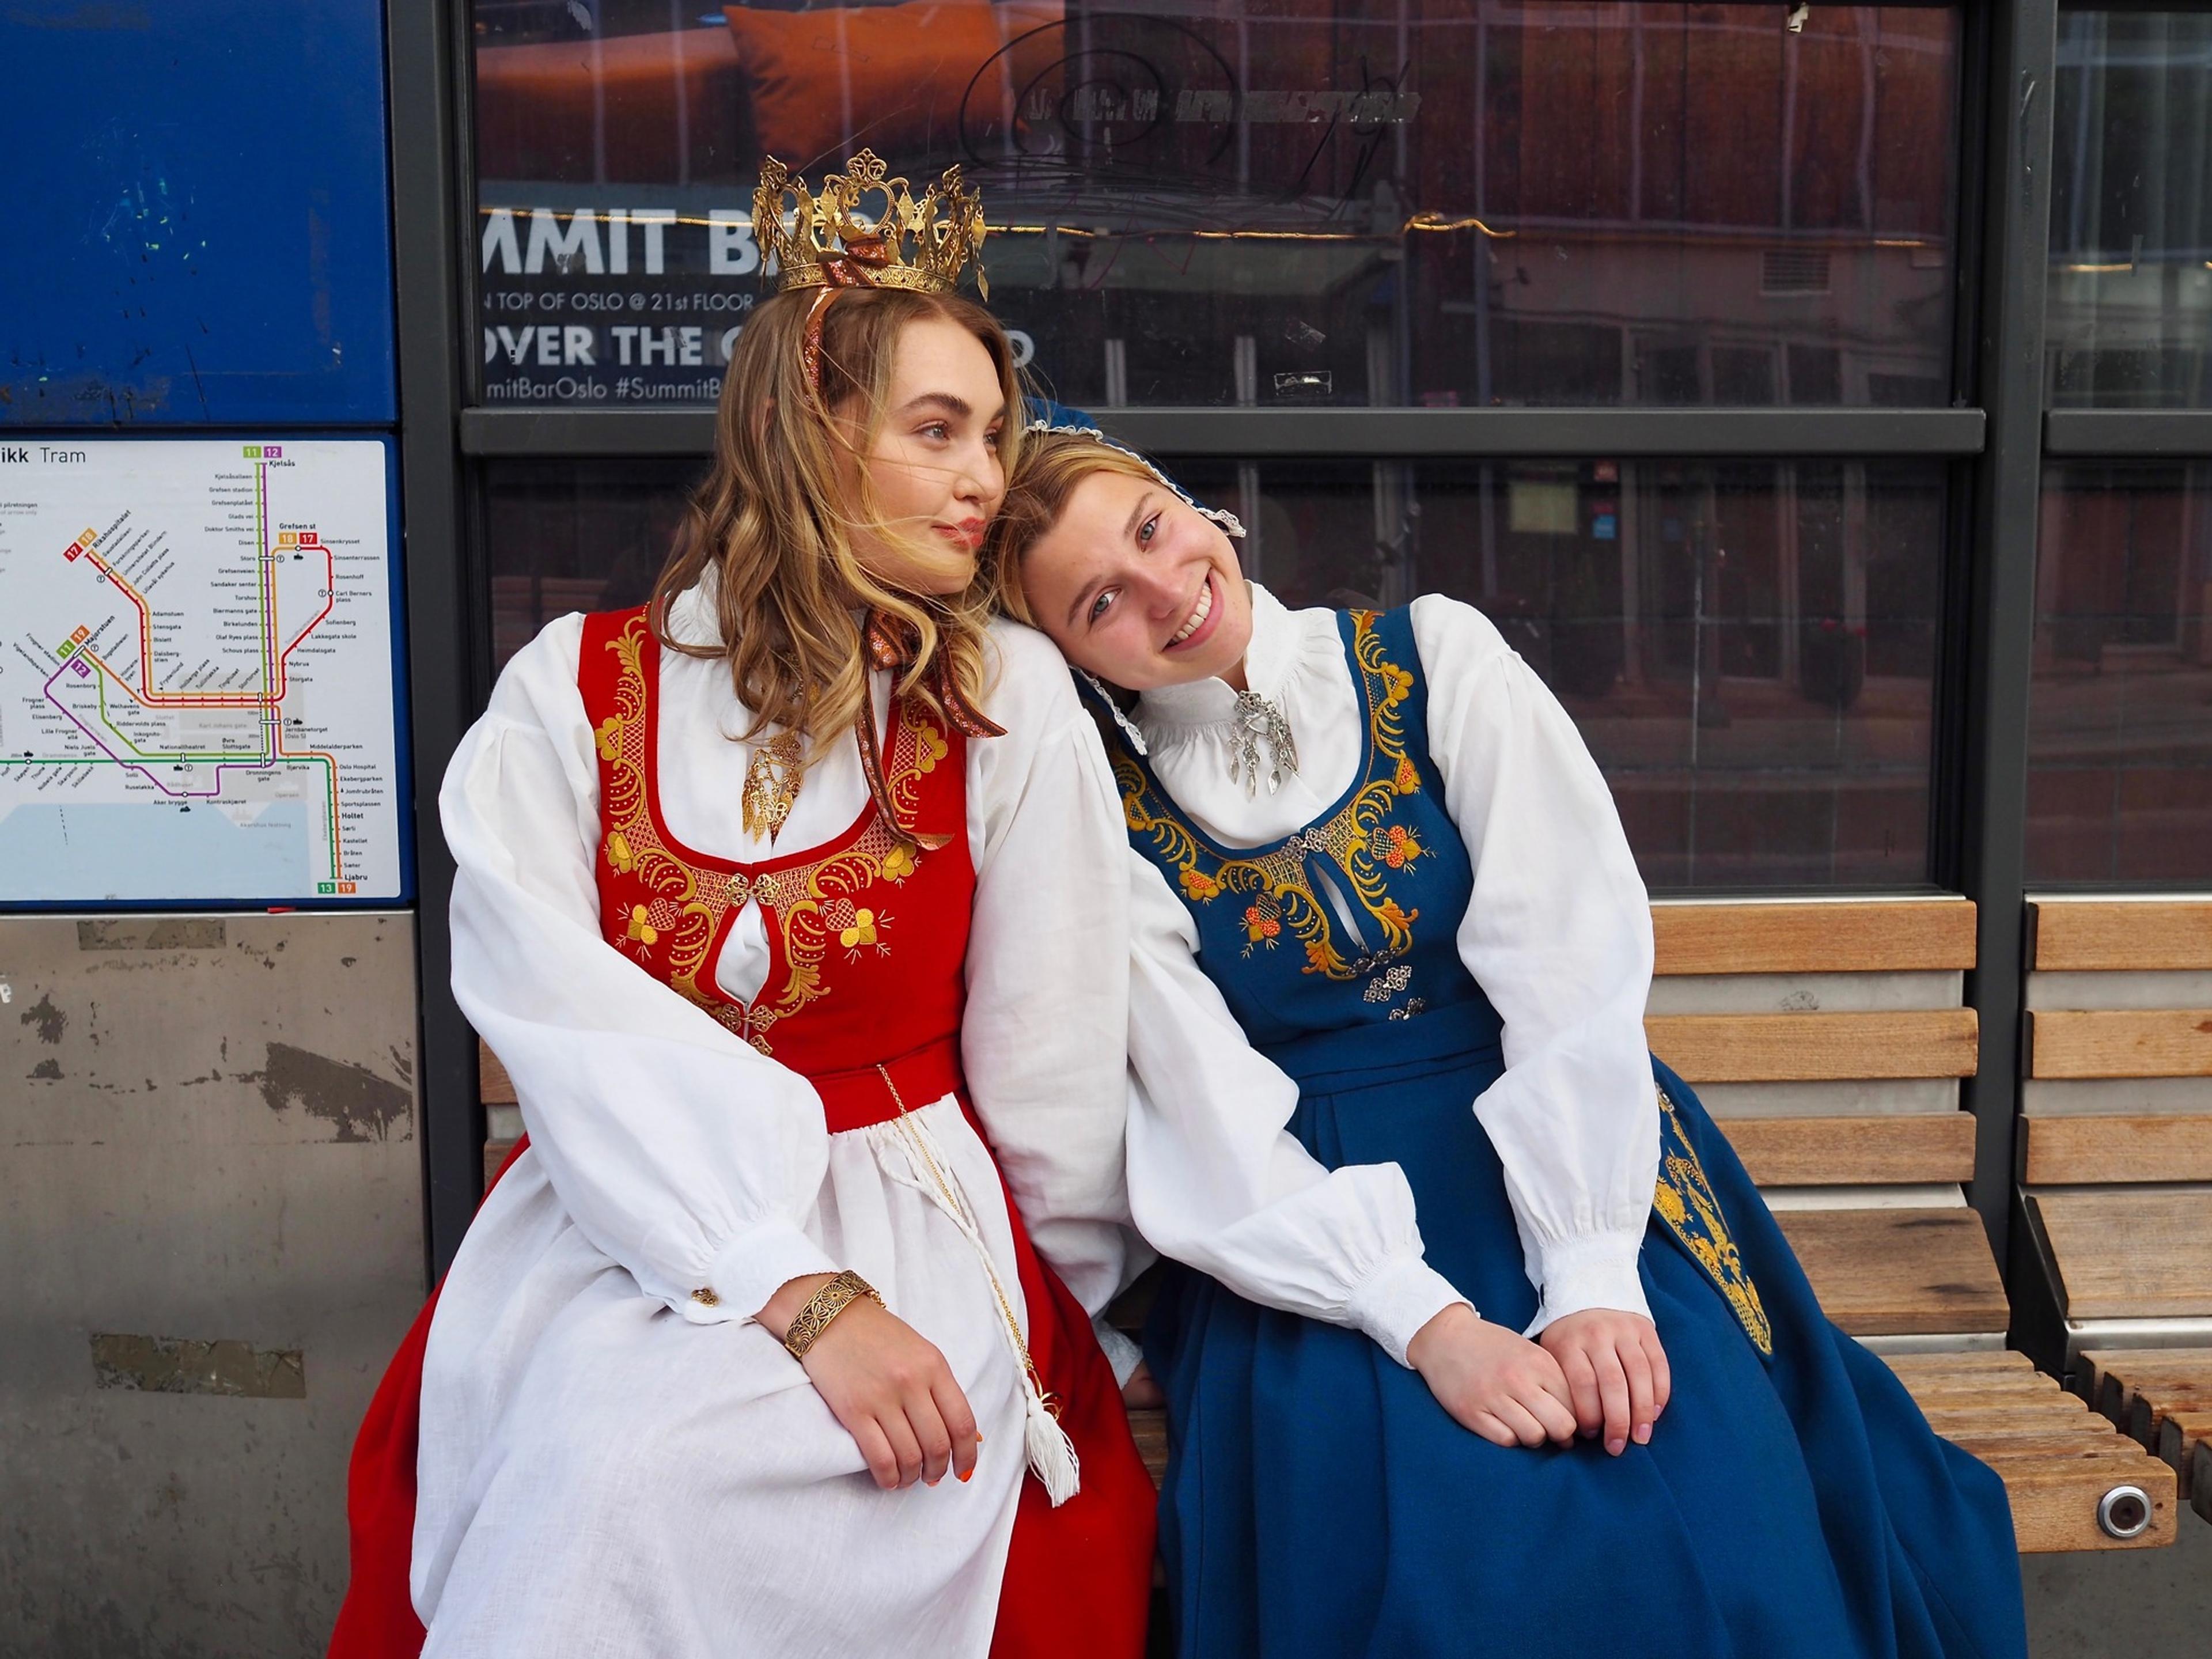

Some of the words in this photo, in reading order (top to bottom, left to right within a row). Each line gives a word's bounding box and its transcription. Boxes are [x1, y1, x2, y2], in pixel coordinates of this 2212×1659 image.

[498, 294, 532, 310] TOP
[539, 294, 565, 310] OF
[571, 293, 624, 311] OSLO
[628, 294, 646, 310] @
[651, 293, 688, 310] 21st
[693, 293, 753, 311] FLOOR
[611, 326, 702, 366] THE
[487, 377, 607, 399] mitBarOslo
[1, 448, 29, 463] ikk
[40, 448, 86, 463] Tram
[247, 449, 257, 457] 11
[267, 449, 278, 457] 12
[269, 460, 296, 468] Kjelsås
[92, 509, 131, 549] Rikshospitalet
[283, 535, 293, 543] 18
[302, 535, 313, 543] 17
[84, 615, 116, 646] Majorstuen
[321, 884, 332, 892] 13
[341, 884, 352, 892] 19
